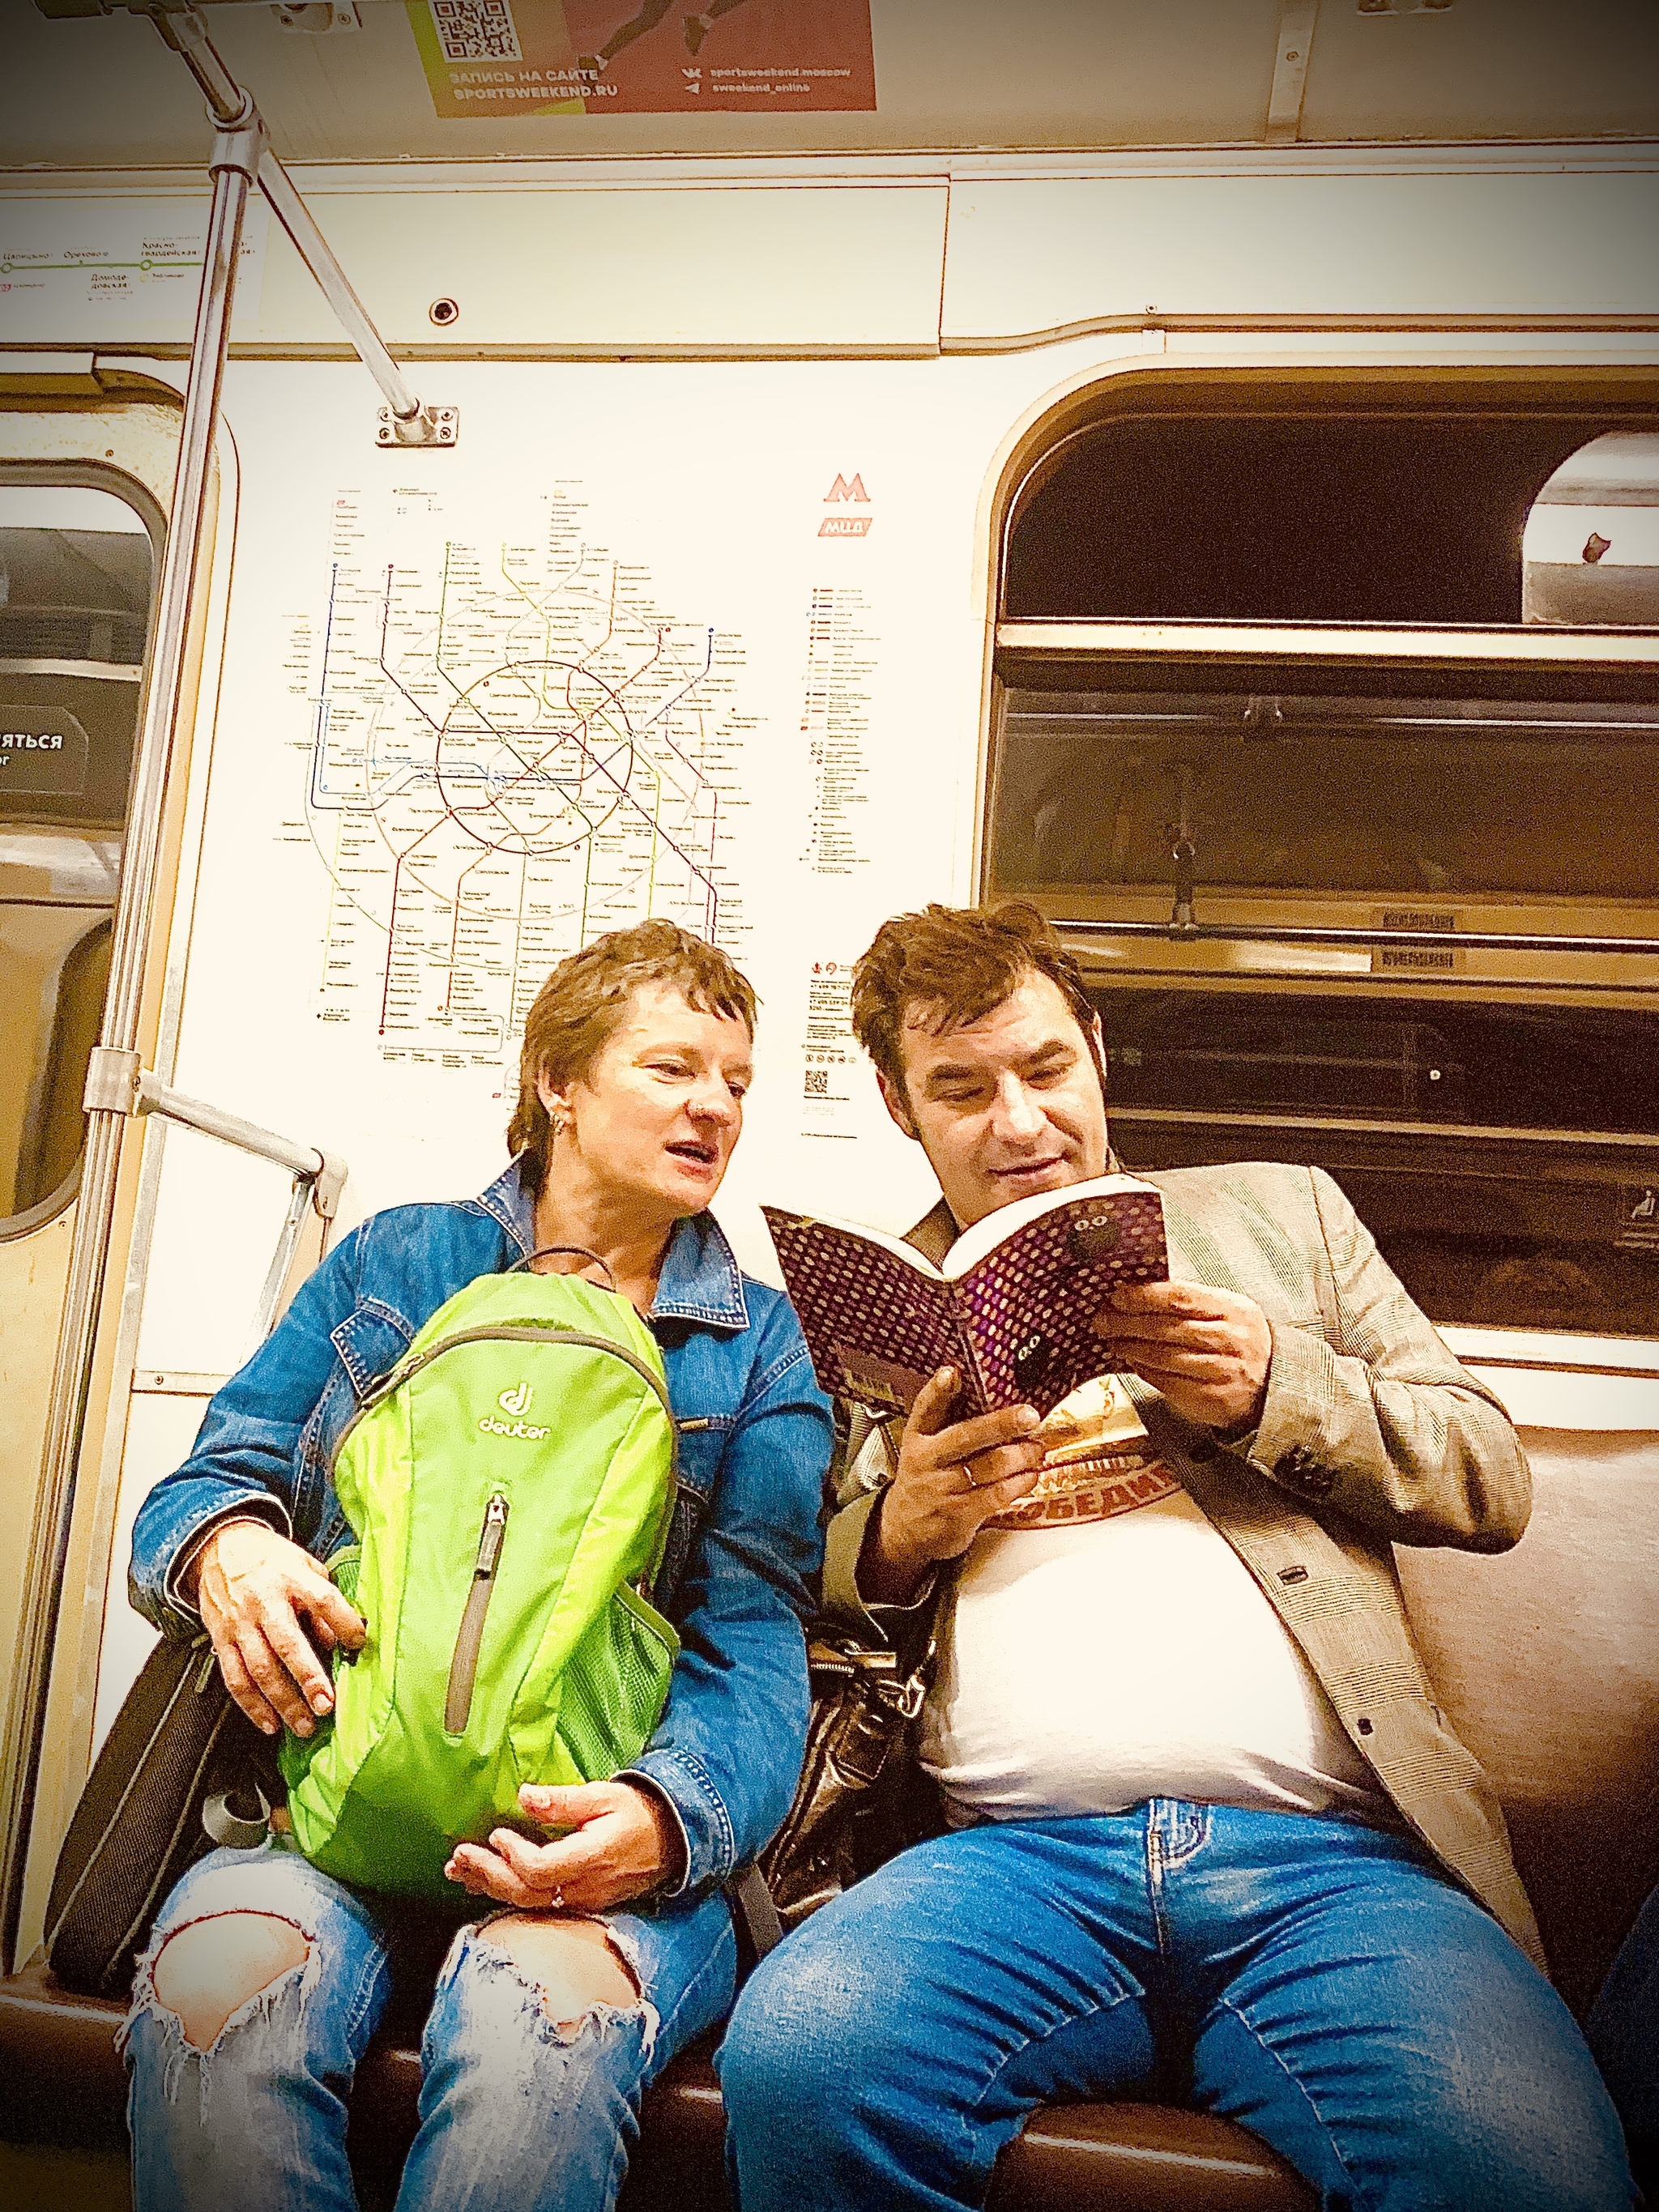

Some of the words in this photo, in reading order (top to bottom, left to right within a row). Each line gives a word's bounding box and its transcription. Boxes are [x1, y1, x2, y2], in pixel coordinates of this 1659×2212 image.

[450, 72, 515, 83] ЗАПИСЬ
[518, 70, 542, 82] НА
[546, 69, 599, 81] САЙТЕ
[454, 85, 618, 100] SPORTSWEEKEND.RU
[63, 251, 102, 259] Орехово
[825, 521, 864, 534] МЦД
[0, 734, 62, 749] ЯТЬСЯ
[479, 1415, 551, 1439] deuter
